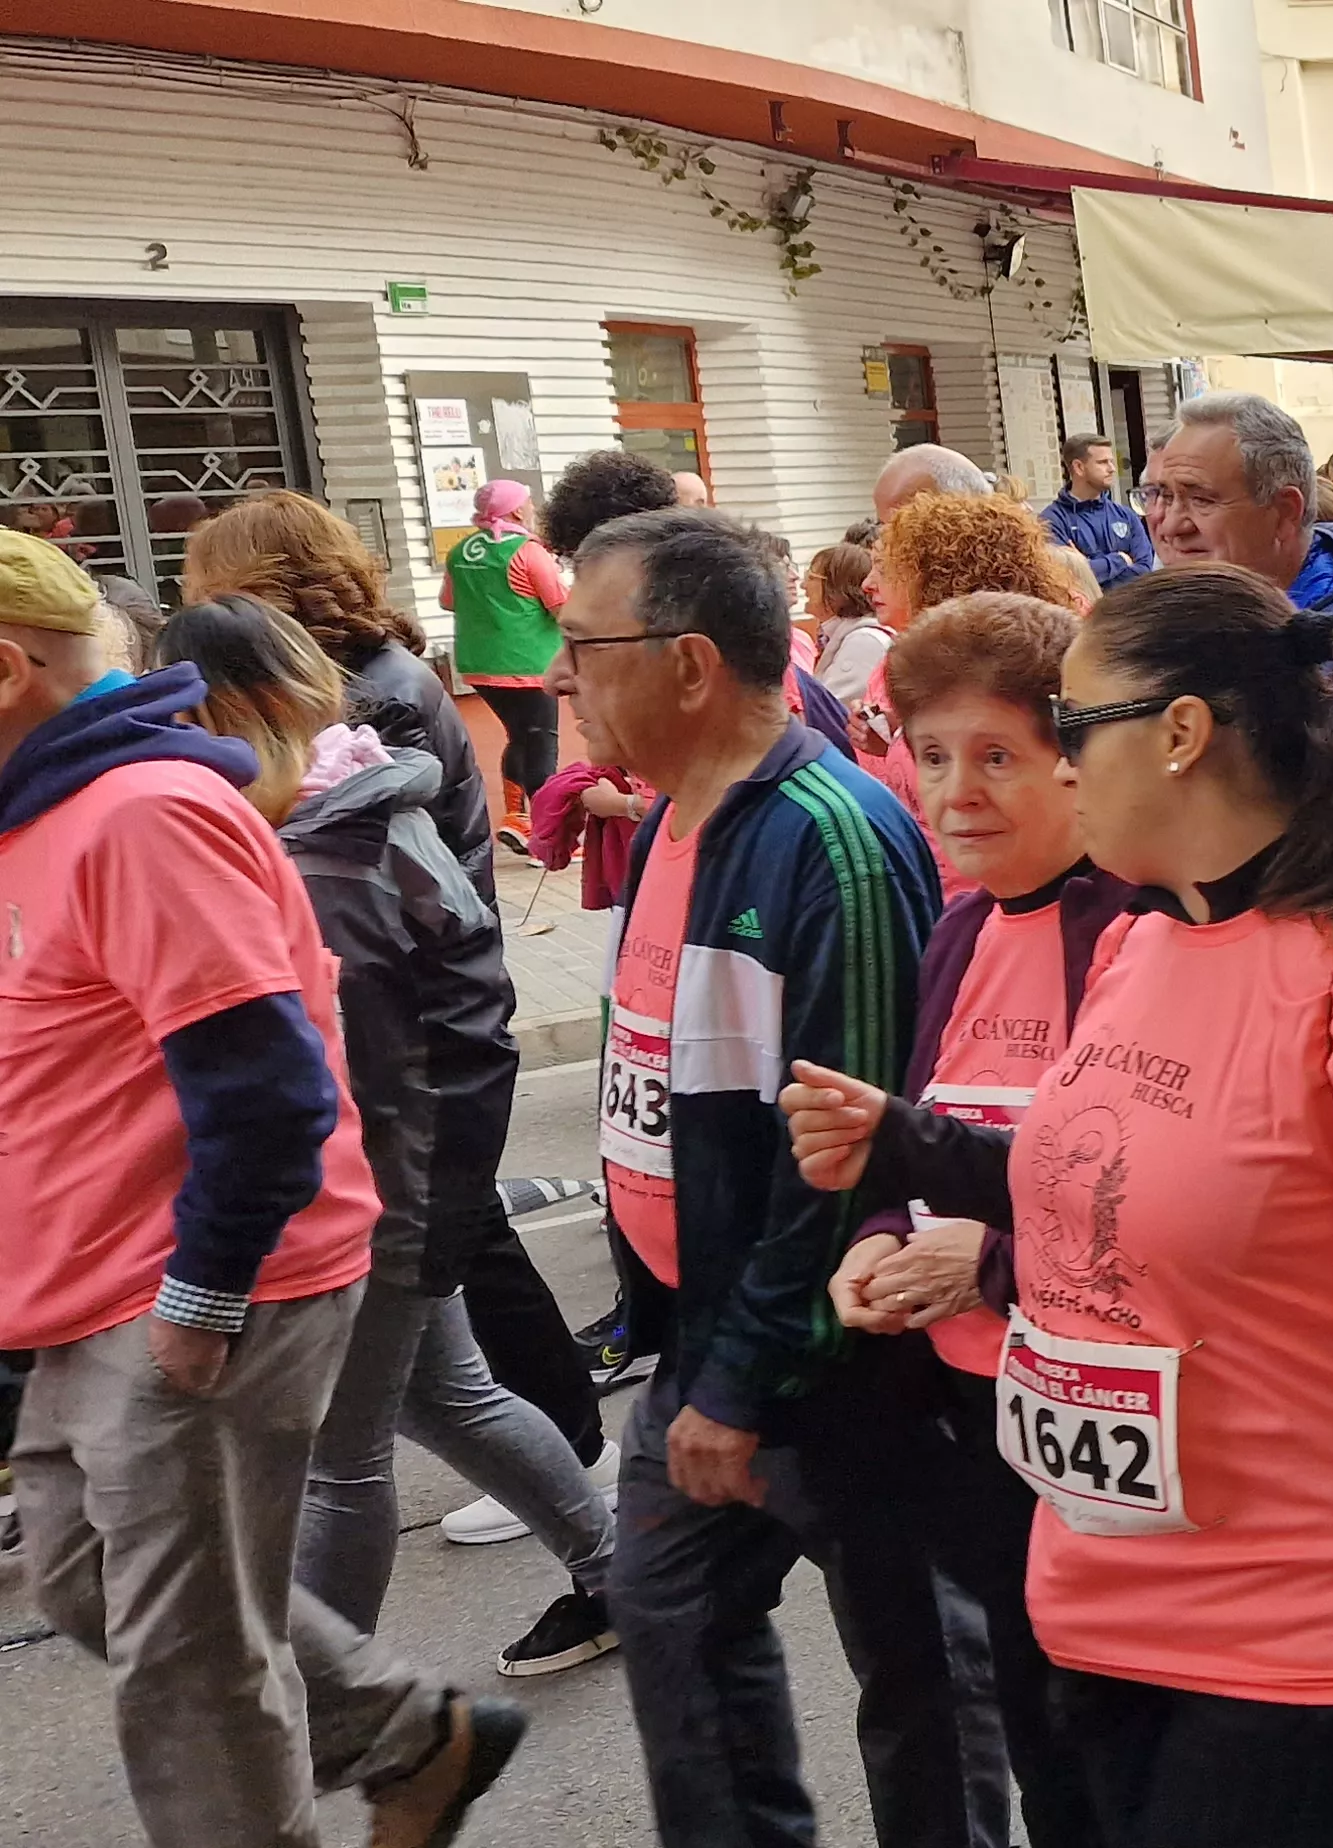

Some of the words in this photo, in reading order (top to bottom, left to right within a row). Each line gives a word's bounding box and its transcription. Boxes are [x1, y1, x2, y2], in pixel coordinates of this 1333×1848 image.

[144, 242, 170, 272] 2
[972, 1014, 1050, 1043] CÁNCER
[1060, 1043, 1104, 1087] 9ª
[1105, 1041, 1191, 1091] CÁNCER
[604, 1061, 669, 1137] 643
[1130, 1082, 1194, 1119] HUESCA
[1050, 1380, 1070, 1401] EL
[1069, 1383, 1151, 1412] CÁNCER
[1007, 1393, 1158, 1500] 1642
